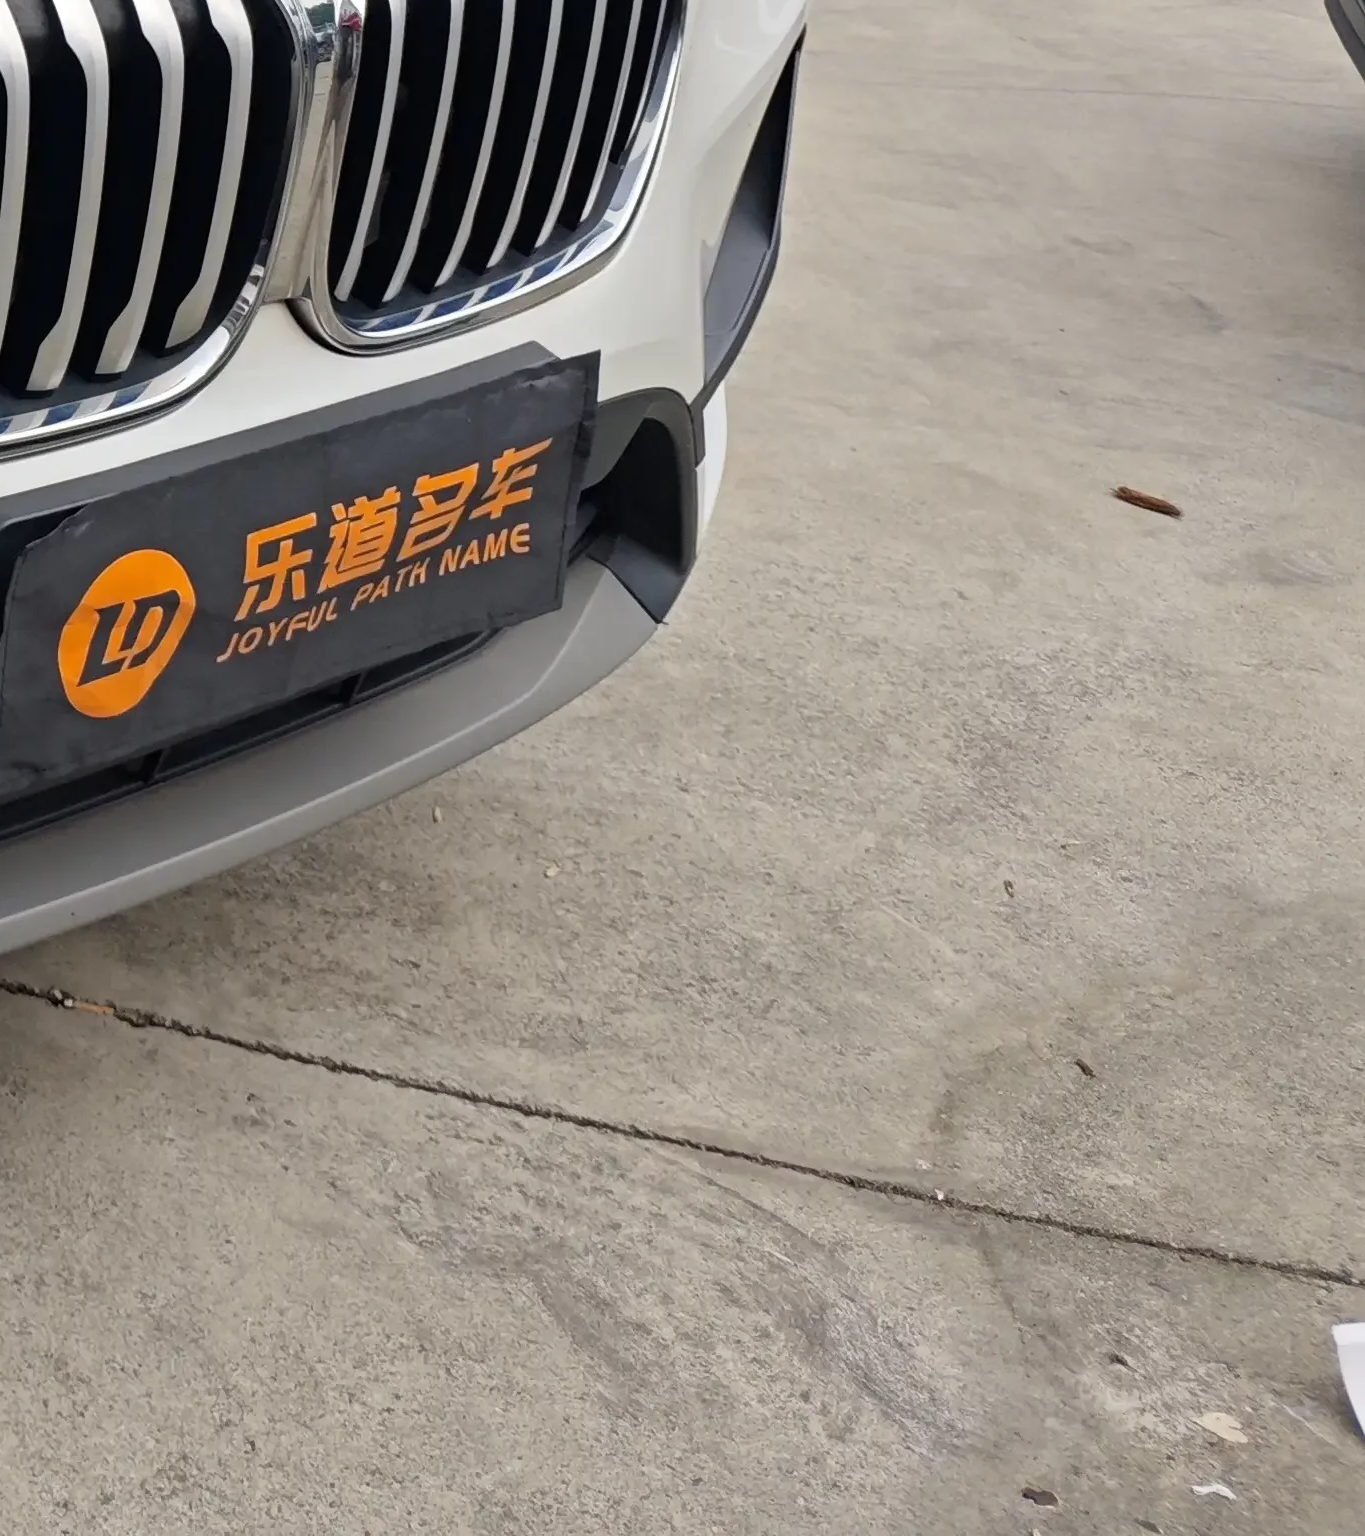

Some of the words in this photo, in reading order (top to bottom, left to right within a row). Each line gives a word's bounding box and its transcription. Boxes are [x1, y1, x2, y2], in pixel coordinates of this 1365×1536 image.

[215, 597, 339, 663] JOYFUL
[350, 560, 428, 612] PATH
[439, 522, 531, 576] NAME
[234, 437, 554, 622] 乐道名车
